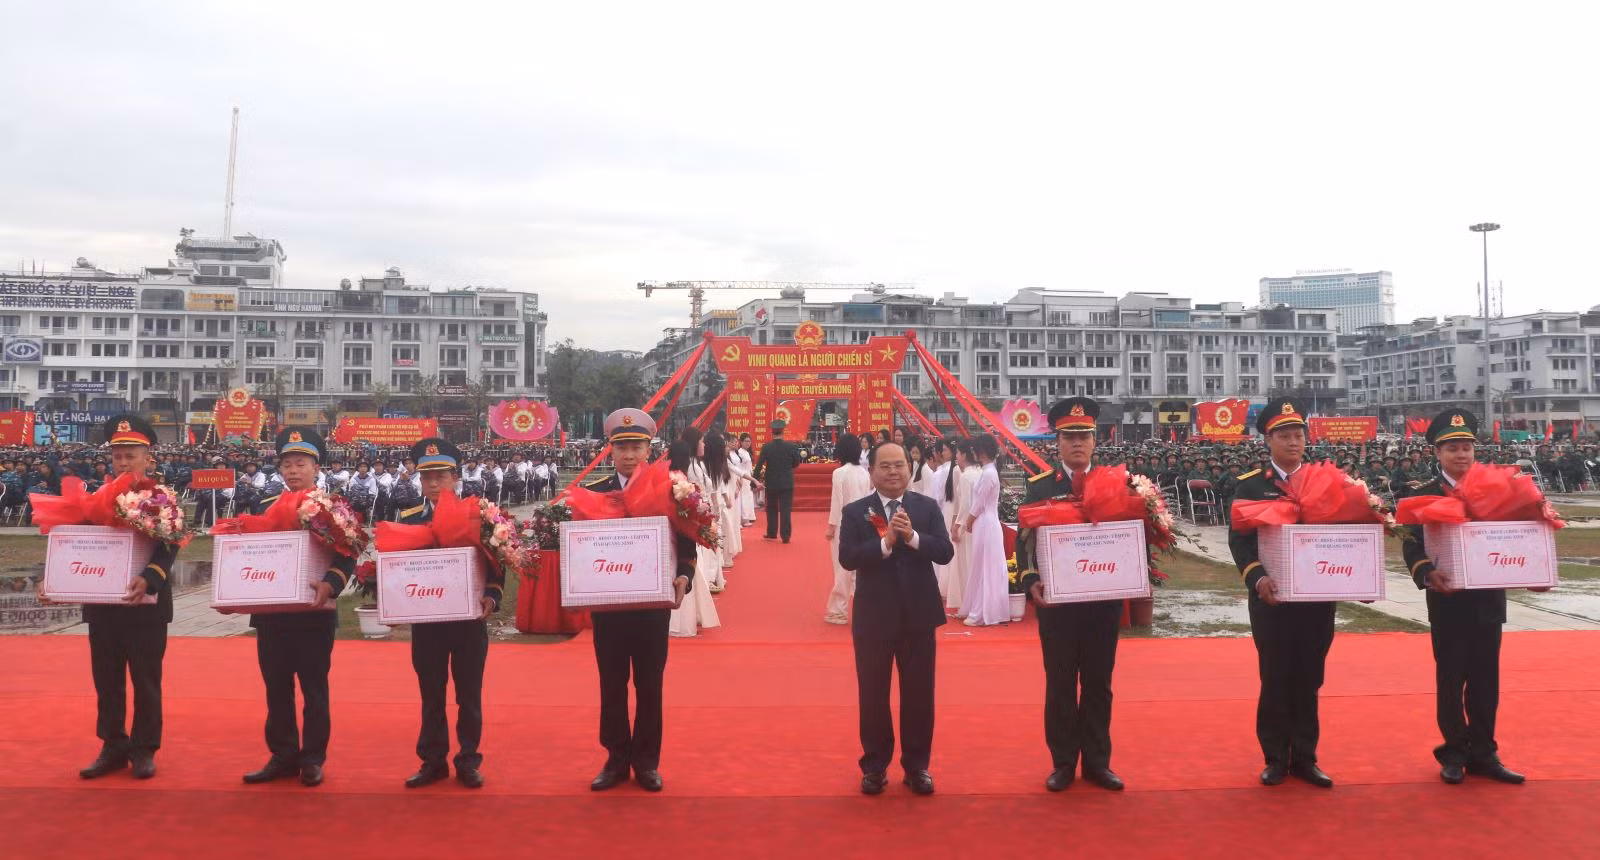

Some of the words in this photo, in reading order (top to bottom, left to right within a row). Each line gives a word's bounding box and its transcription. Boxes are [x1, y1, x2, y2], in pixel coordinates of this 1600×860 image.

[748, 354, 767, 367] VINH
[769, 354, 797, 368] QUANG
[799, 352, 809, 367] LÀ
[810, 351, 835, 366] NGƯỜI
[837, 350, 862, 366] CHIẾN
[781, 384, 800, 395] BƯỚC
[802, 384, 828, 395] TRUYỀN
[830, 384, 852, 394] THỐNG
[71, 412, 92, 423] NGA
[593, 559, 633, 575] Tặng
[1076, 559, 1116, 575] Tặng
[1488, 552, 1526, 568] Tặng
[70, 562, 106, 577] Tặng
[240, 567, 276, 582] Tặng
[1315, 561, 1353, 577] Tặng
[404, 584, 444, 599] Tặng
